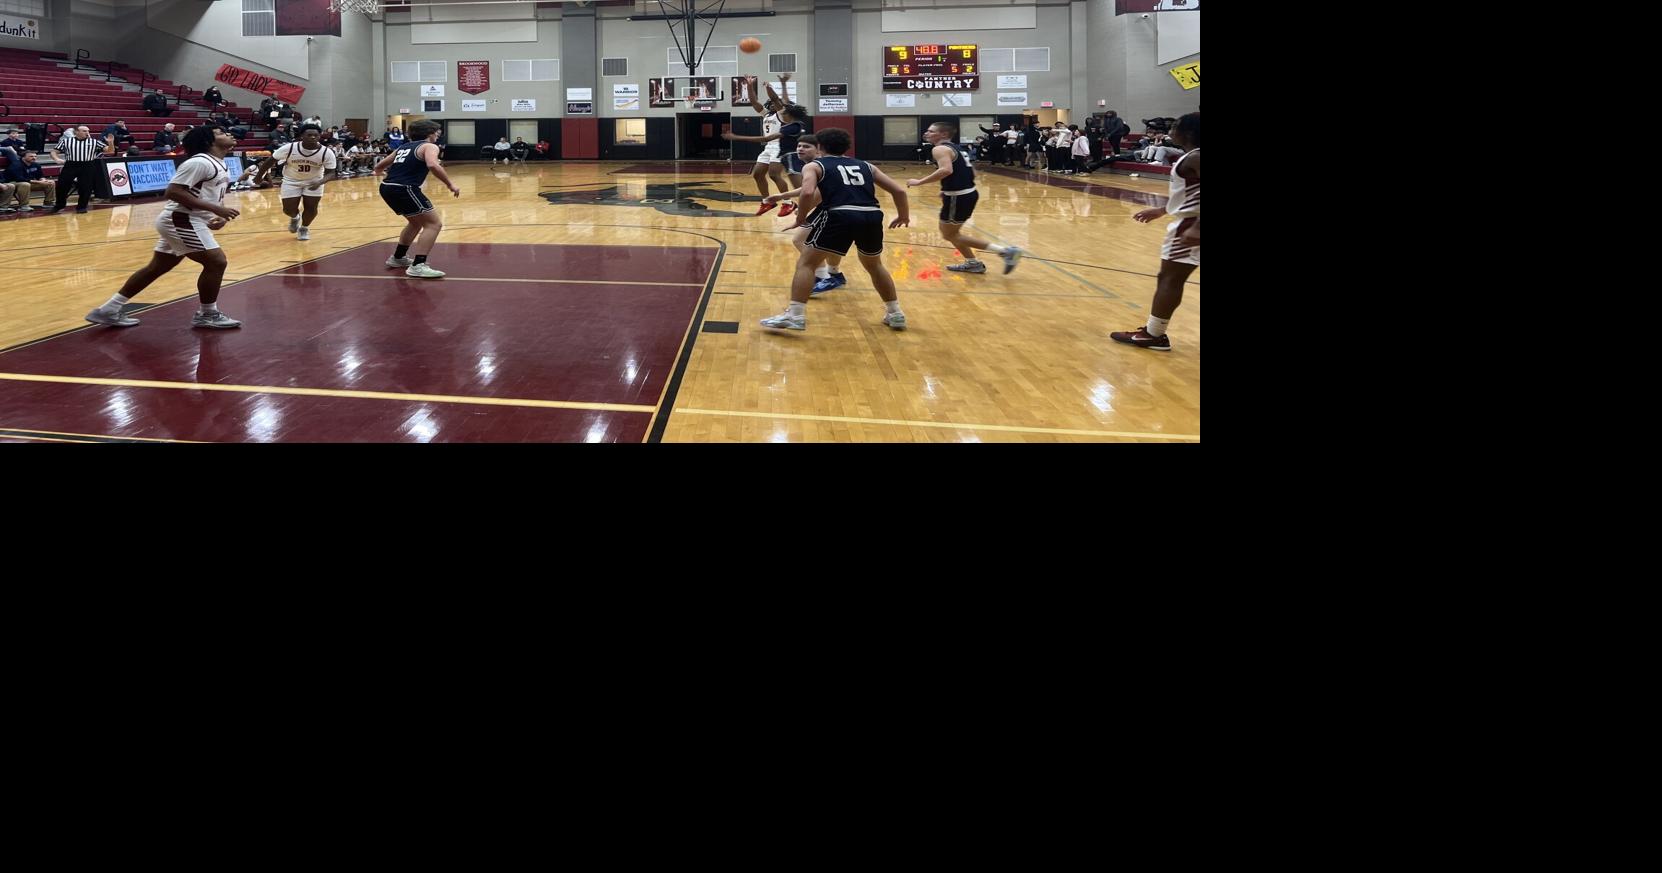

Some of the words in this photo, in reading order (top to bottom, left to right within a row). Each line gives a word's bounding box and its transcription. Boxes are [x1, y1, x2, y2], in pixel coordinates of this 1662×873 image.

[915, 45, 938, 54] 48.8
[963, 49, 971, 58] 8
[899, 51, 907, 60] 9
[765, 125, 770, 133] 5
[394, 149, 411, 163] 22
[128, 163, 150, 174] DON'T
[151, 162, 168, 172] WAIT
[131, 172, 170, 184] VACCINATE
[837, 165, 865, 186] 15
